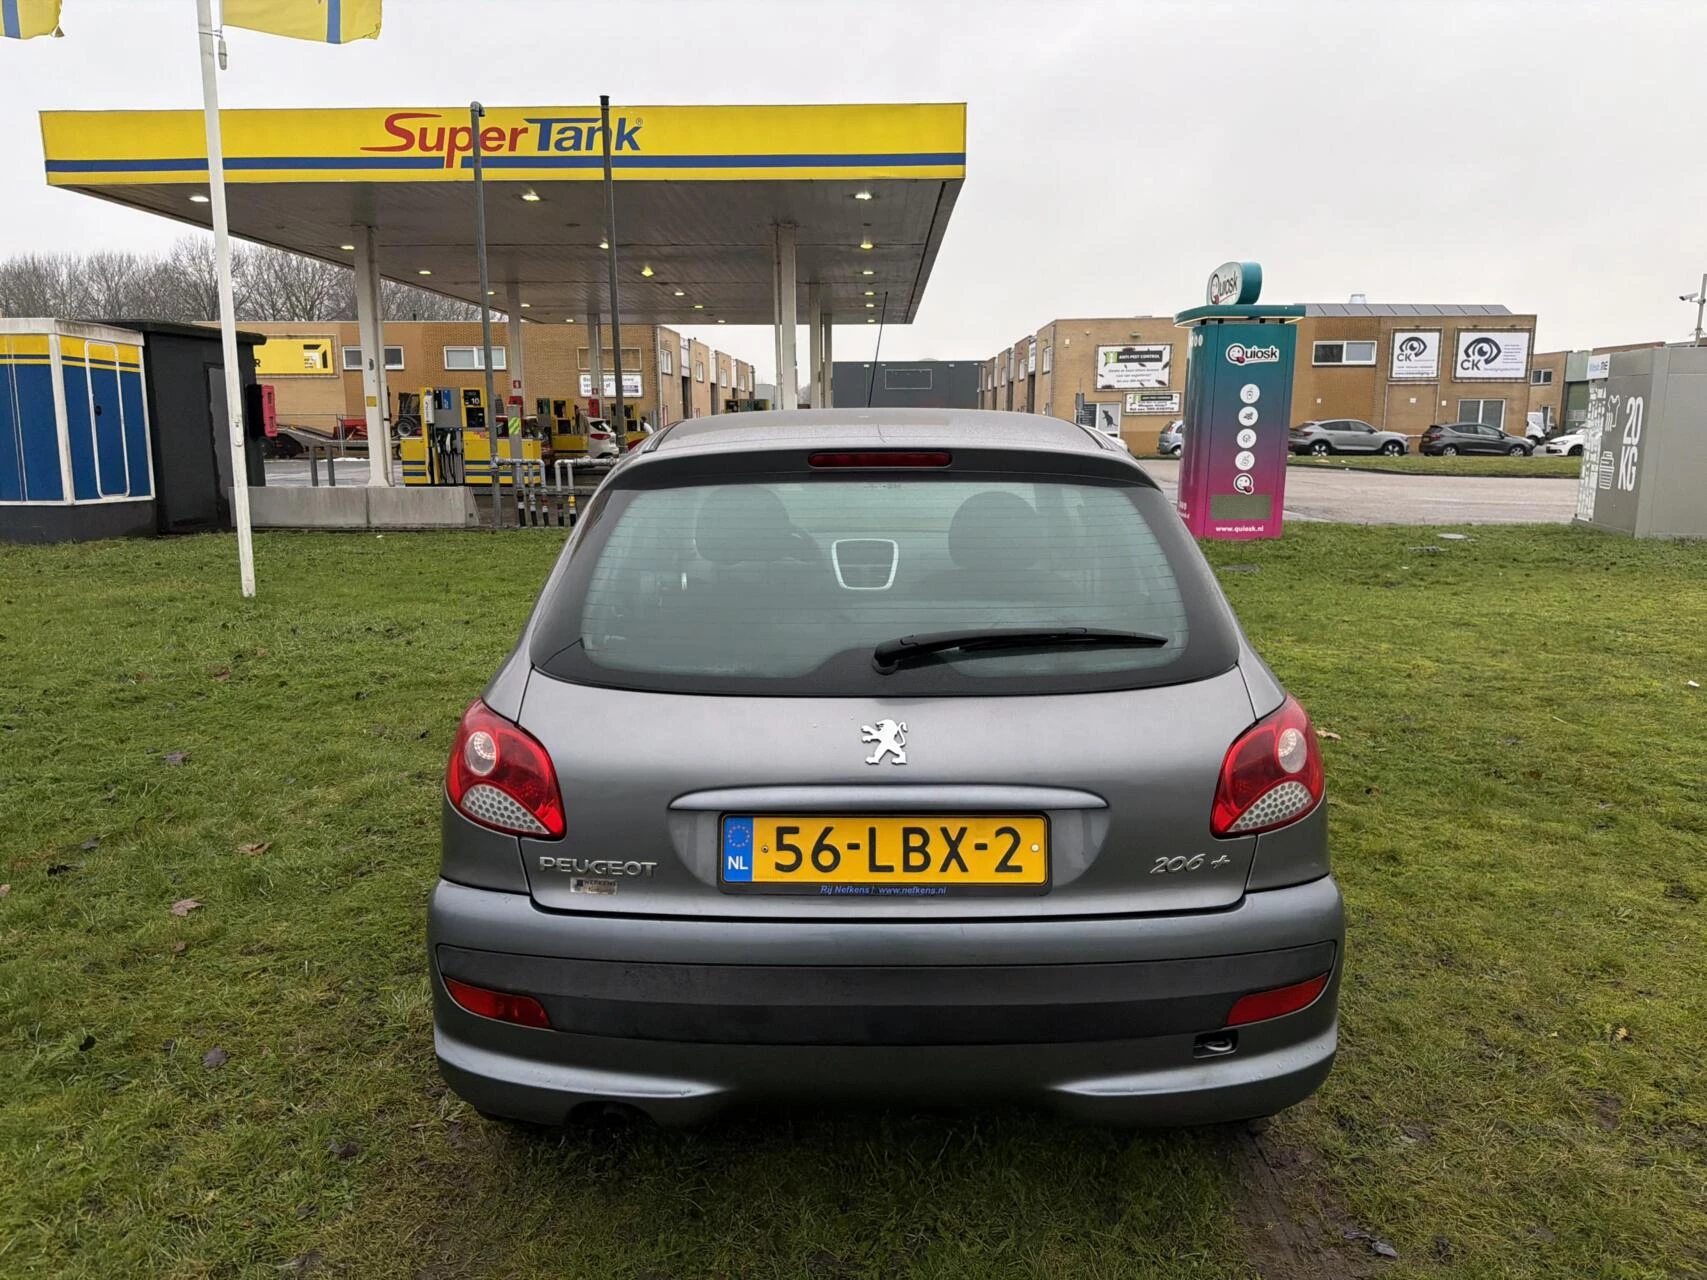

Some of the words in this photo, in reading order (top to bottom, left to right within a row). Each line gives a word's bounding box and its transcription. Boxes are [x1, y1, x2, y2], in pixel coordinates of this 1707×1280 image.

[1210, 272, 1238, 304] Quiosk
[1227, 345, 1278, 363] Quiosk
[1396, 353, 1412, 362] CK
[1460, 359, 1481, 371] CK
[1623, 396, 1643, 445] 20
[1617, 445, 1638, 491] KG
[1215, 525, 1264, 533] www.quiosk.nl
[774, 826, 1023, 873] 56-LBX-2
[539, 856, 657, 876] PEUGEOT
[727, 856, 748, 871] NL
[835, 885, 870, 894] Nefkens
[878, 885, 946, 895] www.nefkens.nl
